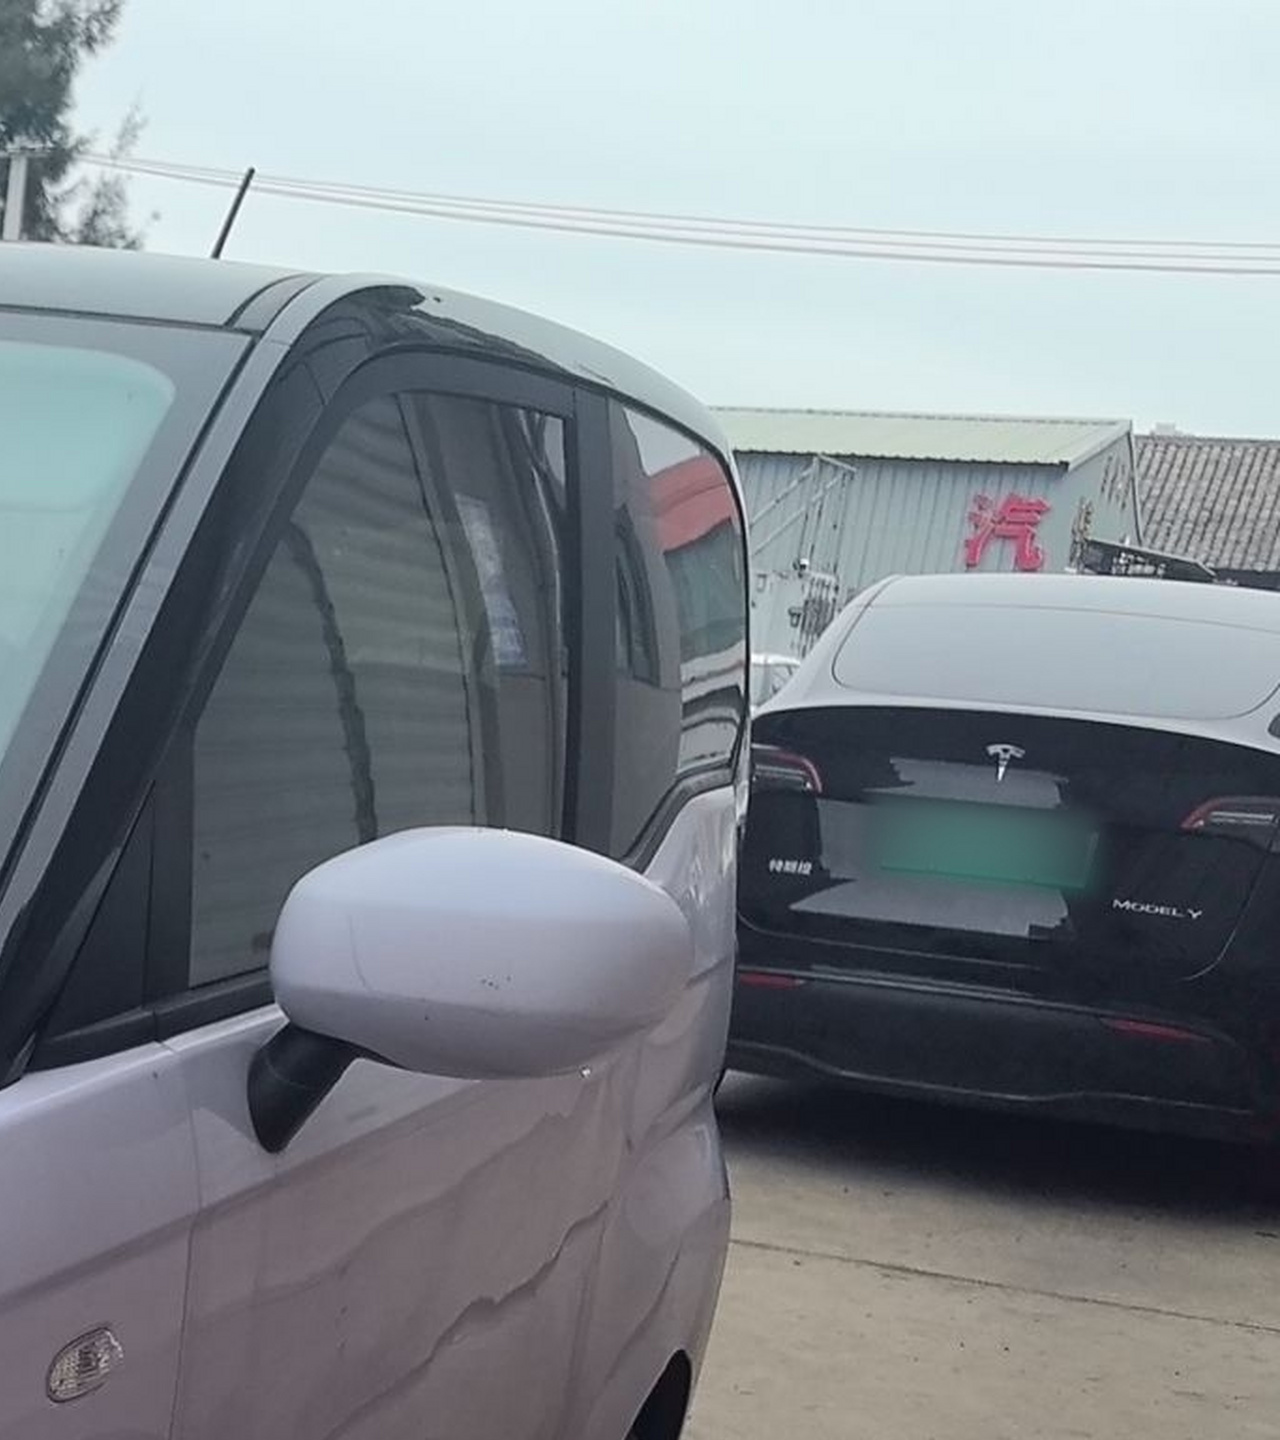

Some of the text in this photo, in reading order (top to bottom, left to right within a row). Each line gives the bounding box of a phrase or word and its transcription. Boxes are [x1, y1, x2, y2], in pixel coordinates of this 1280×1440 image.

[964, 493, 1051, 570] 汽
[1112, 898, 1203, 919] MODEL Y
